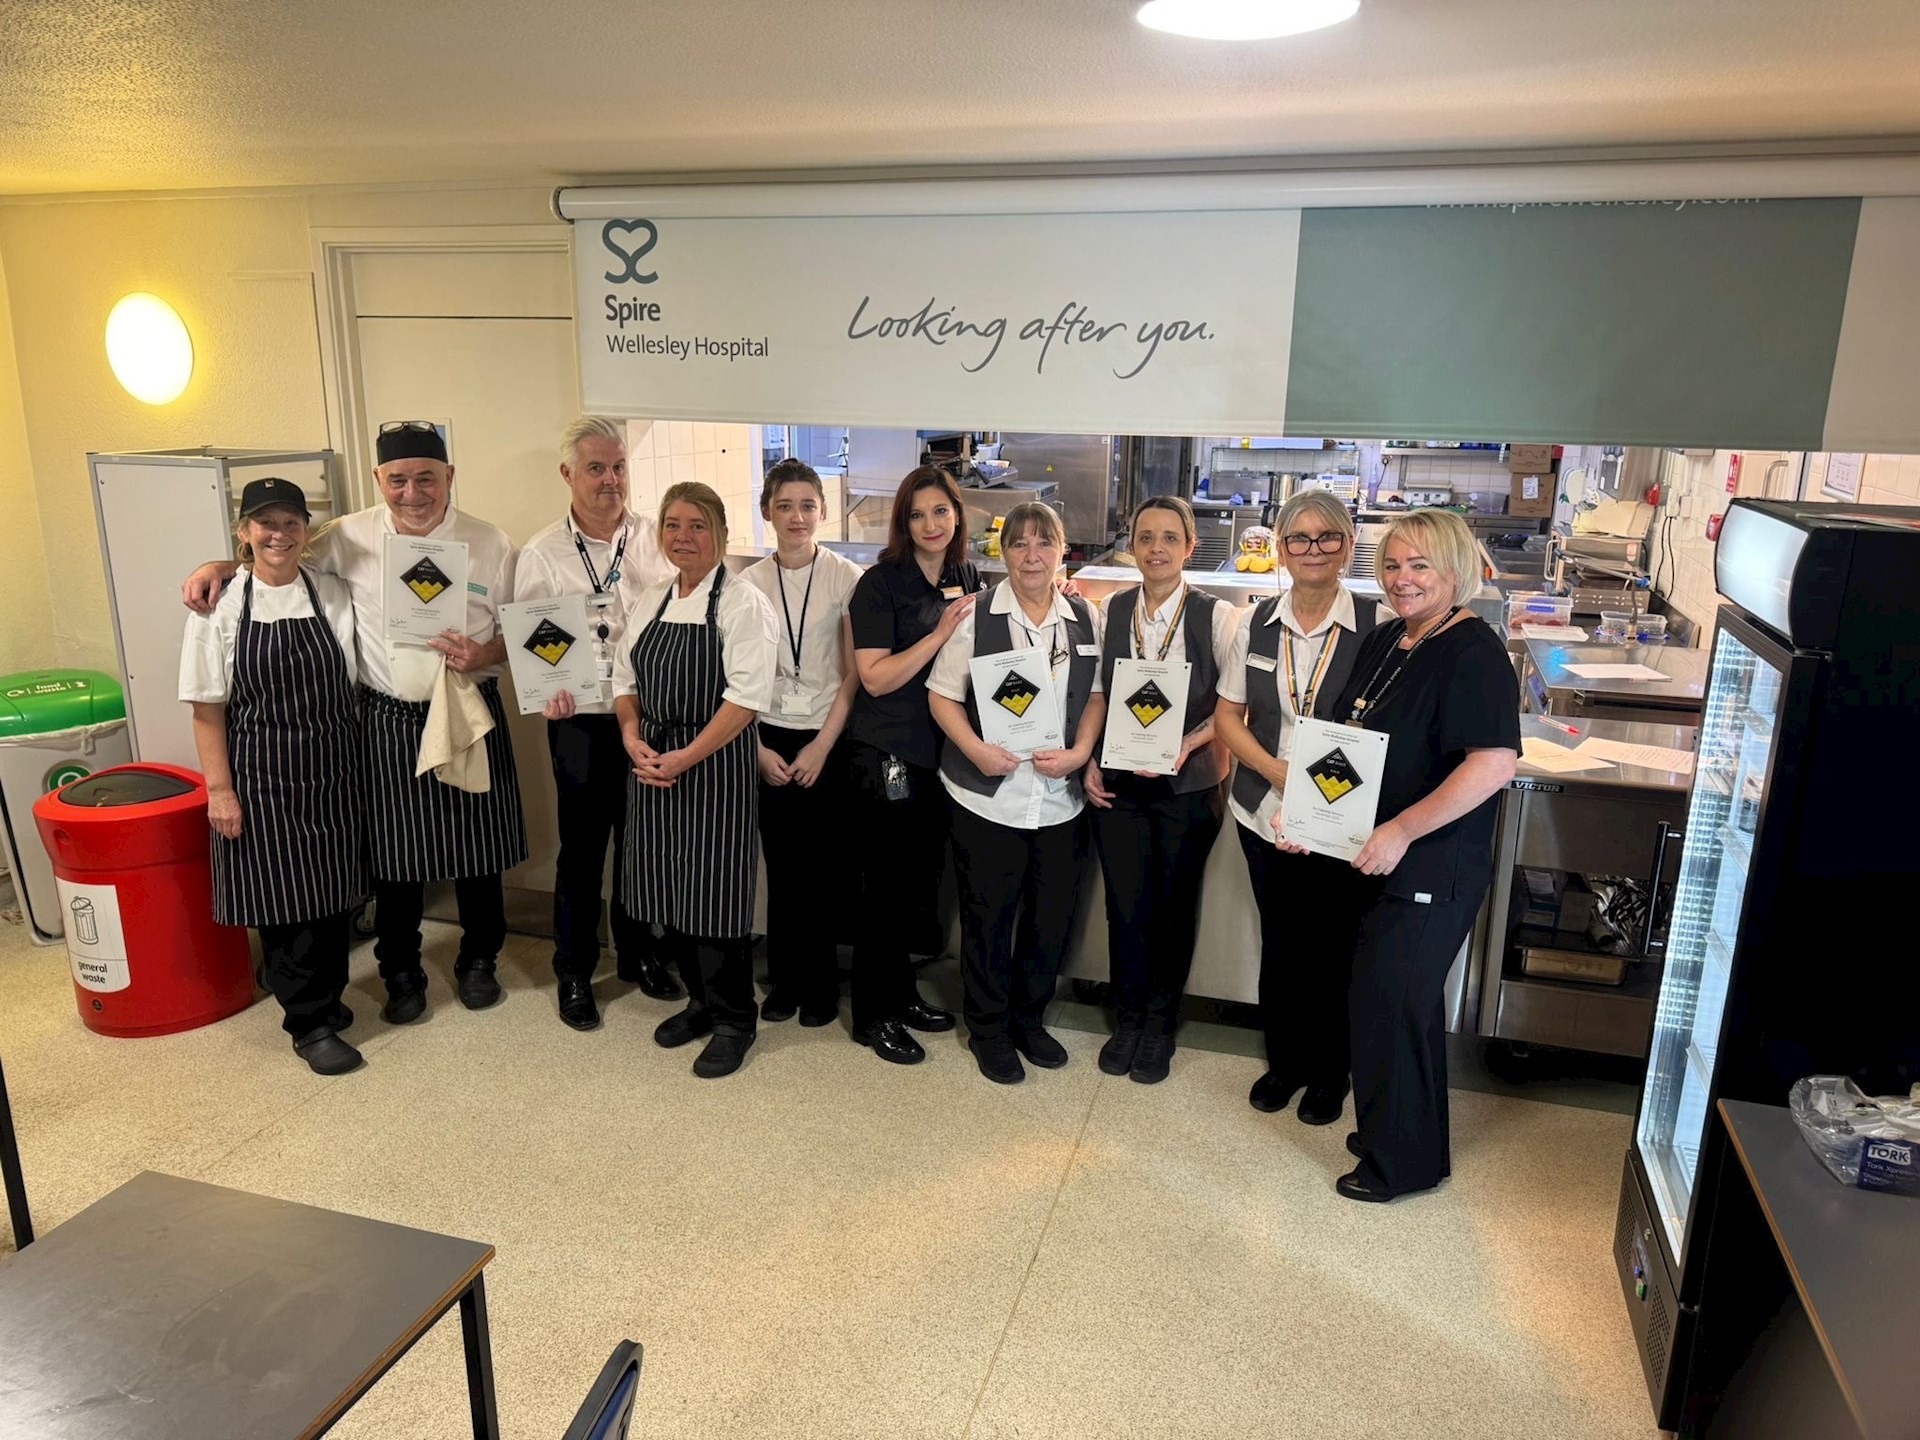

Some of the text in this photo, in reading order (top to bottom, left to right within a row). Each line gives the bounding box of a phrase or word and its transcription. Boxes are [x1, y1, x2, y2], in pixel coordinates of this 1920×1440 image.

[604, 294, 661, 326] Spire
[847, 296, 1215, 379] Looking after you.
[606, 335, 768, 362] Wellesley Hospital
[1515, 781, 1560, 792] VICTOR
[78, 961, 107, 973] general
[82, 973, 105, 984] waste
[1871, 1147, 1908, 1162] TORK
